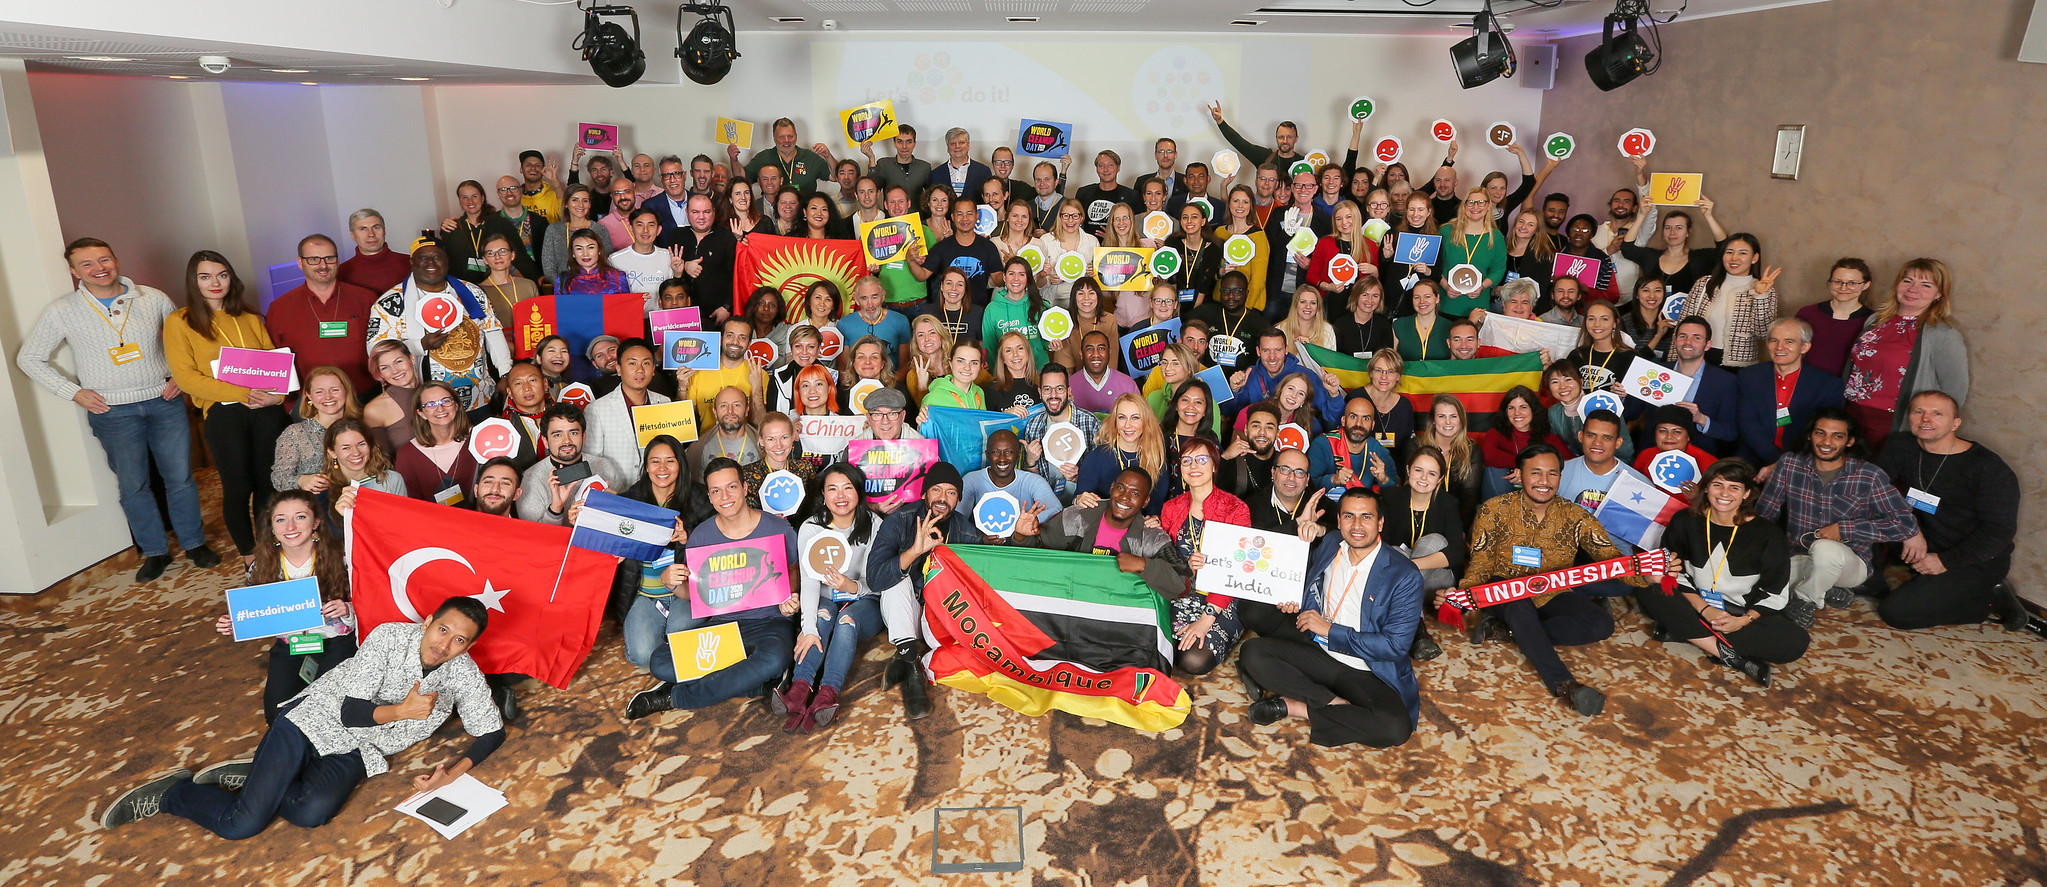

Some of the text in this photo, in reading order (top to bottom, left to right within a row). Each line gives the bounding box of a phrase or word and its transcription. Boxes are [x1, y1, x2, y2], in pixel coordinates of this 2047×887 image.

[851, 110, 873, 123] WORLD
[854, 130, 866, 140] DAY
[1030, 126, 1052, 137] WORLD
[1025, 143, 1038, 151] DAY
[1027, 135, 1055, 145] CLEANUP
[873, 225, 898, 239] WORLD
[874, 233, 904, 248] CLEANUP
[875, 246, 889, 258] DAY
[1106, 254, 1131, 265] WORLD
[1105, 264, 1135, 274] CLEANUP
[1103, 274, 1118, 285] DAY
[653, 321, 700, 332] #worldcleanupday
[1133, 333, 1159, 349] WORLD
[1135, 341, 1166, 359] CLEANUP
[1138, 356, 1152, 369] DAY
[221, 365, 288, 378] #letsdoitworld
[639, 418, 692, 432] #letsdoitworld
[806, 420, 856, 437] China
[867, 450, 902, 465] WORLD
[865, 465, 910, 479] CLEANUP
[864, 479, 884, 493] DAY
[708, 552, 747, 572] WORLD
[1204, 555, 1303, 583] Let's do it!
[708, 566, 757, 588] CLEANUP
[1484, 561, 1626, 603] INDONESIA
[1224, 575, 1273, 597] India
[708, 586, 731, 604] DAY
[236, 598, 317, 622] #letsdoitworld
[941, 589, 1112, 689] Moçambique
